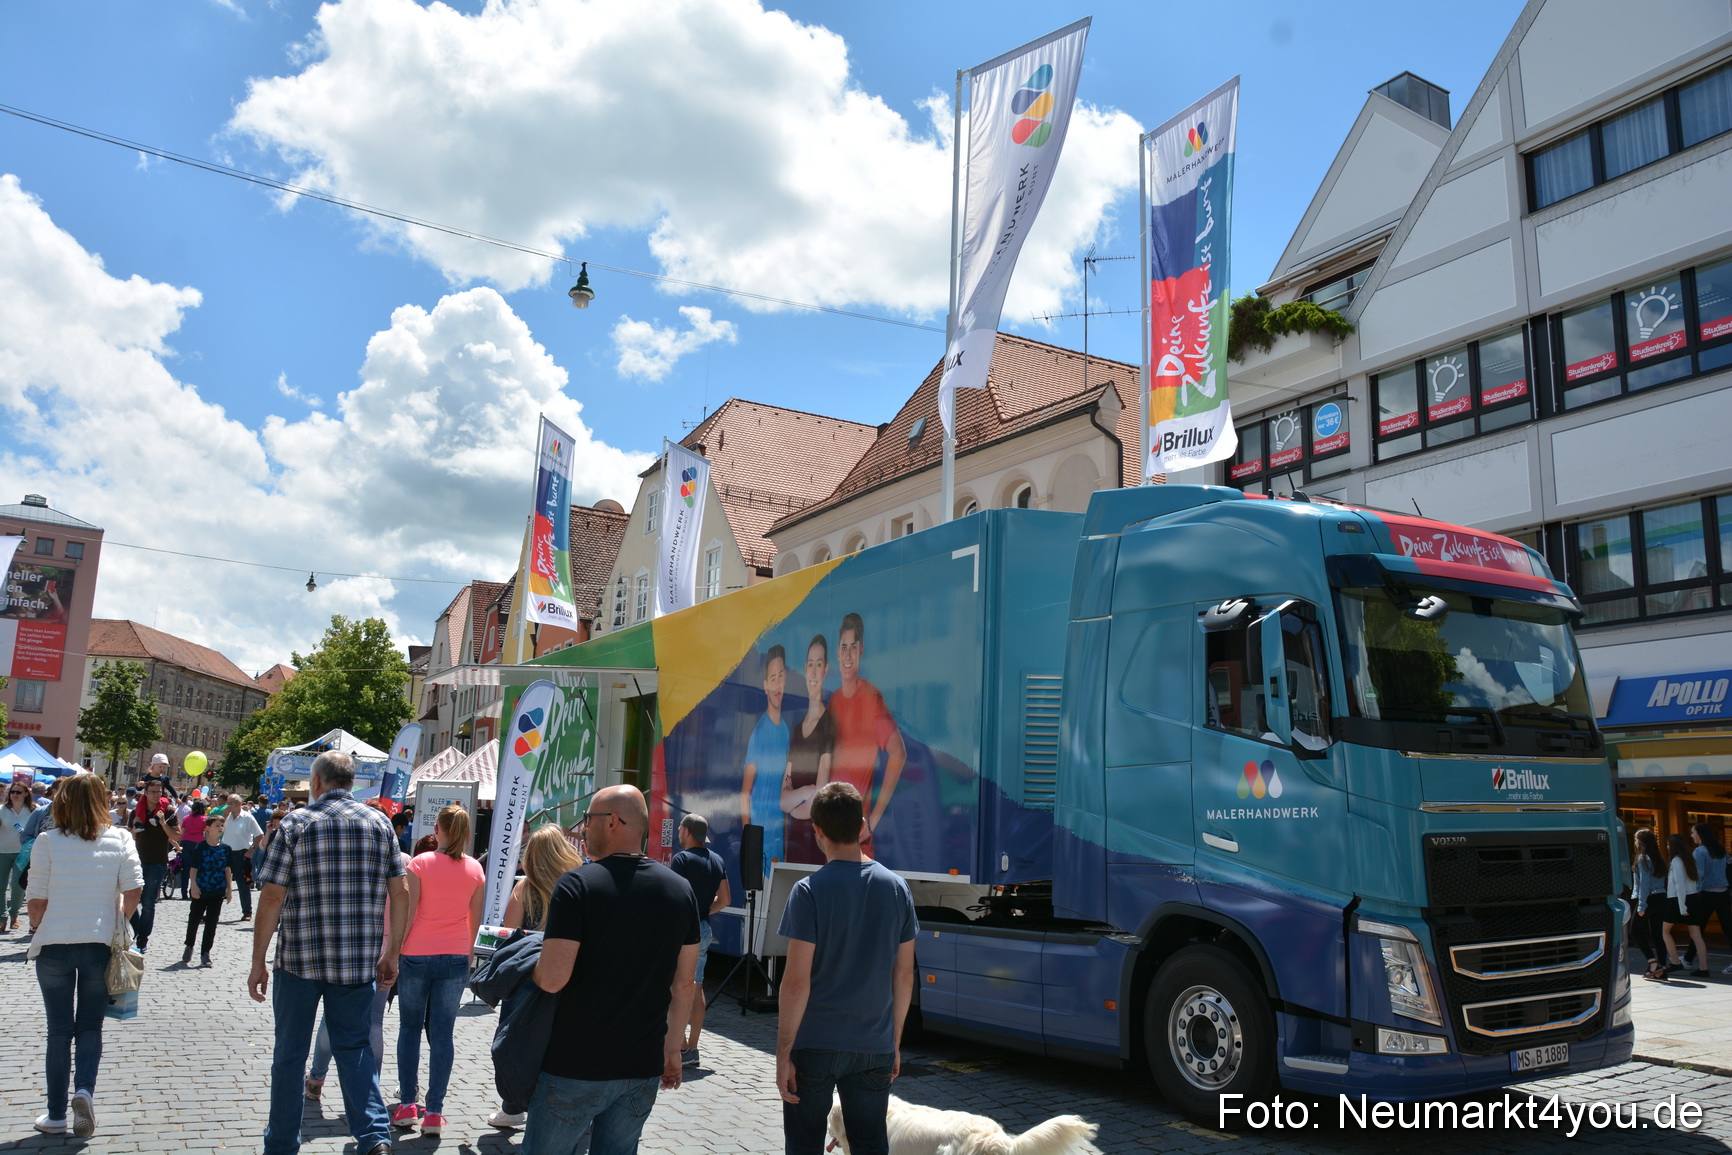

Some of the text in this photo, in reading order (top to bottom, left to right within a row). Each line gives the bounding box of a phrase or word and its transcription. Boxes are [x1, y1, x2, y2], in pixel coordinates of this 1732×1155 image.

[1195, 177, 1214, 244] bunt
[1156, 314, 1185, 377] Deine
[1181, 279, 1218, 407] Zukunft
[1632, 340, 1674, 357] Studienkreis
[1568, 361, 1606, 377] Studienkreis
[1483, 387, 1518, 401] Studienkreis
[1430, 403, 1462, 418] Studienkreis
[1381, 419, 1411, 432] Studienkreis
[1164, 426, 1215, 453] Brillux
[1315, 439, 1341, 451] Studienkreis
[1270, 452, 1296, 464] Studienkreis
[1232, 464, 1256, 476] Studienkreis
[547, 475, 560, 506] bunt
[670, 509, 685, 605] MALERHANDWERK
[1398, 533, 1526, 567] Deine Zukunft ist bunt
[1647, 678, 1730, 708] APOLLO
[549, 687, 588, 745] Deine
[1685, 704, 1723, 715] OPTIK
[531, 729, 595, 817] Zukunft
[1506, 769, 1551, 790] Brillux
[391, 772, 405, 799] bunt
[1529, 792, 1544, 800] Farbe
[1206, 807, 1319, 820] MALERHANDWERK
[1430, 836, 1467, 846] VOLVO
[1517, 1045, 1568, 1068] MS B 1889
